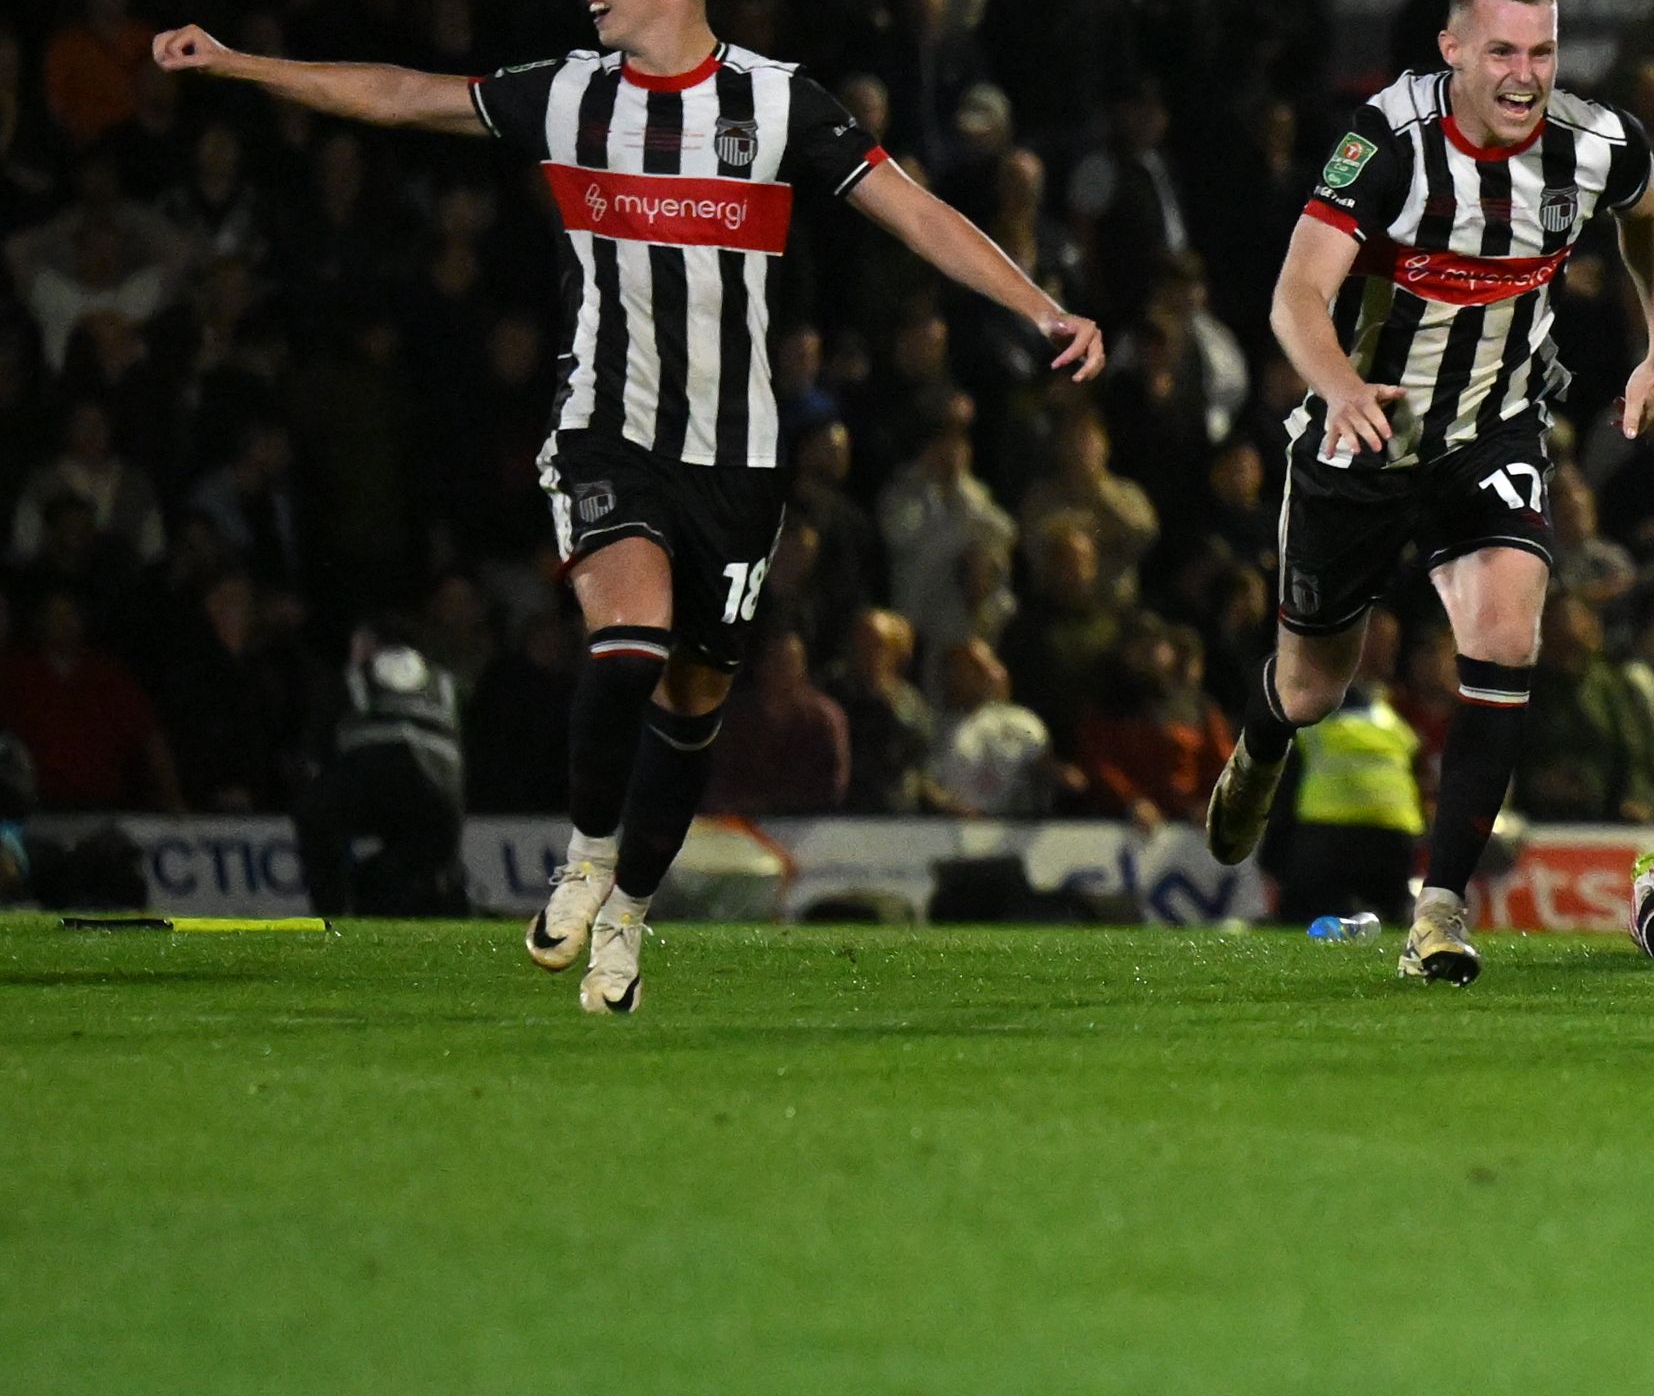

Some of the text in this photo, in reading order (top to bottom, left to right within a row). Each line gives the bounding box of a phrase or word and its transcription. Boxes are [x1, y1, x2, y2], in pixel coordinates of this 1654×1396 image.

[614, 193, 747, 230] myenergi
[1478, 462, 1542, 513] 17
[722, 556, 767, 624] 18
